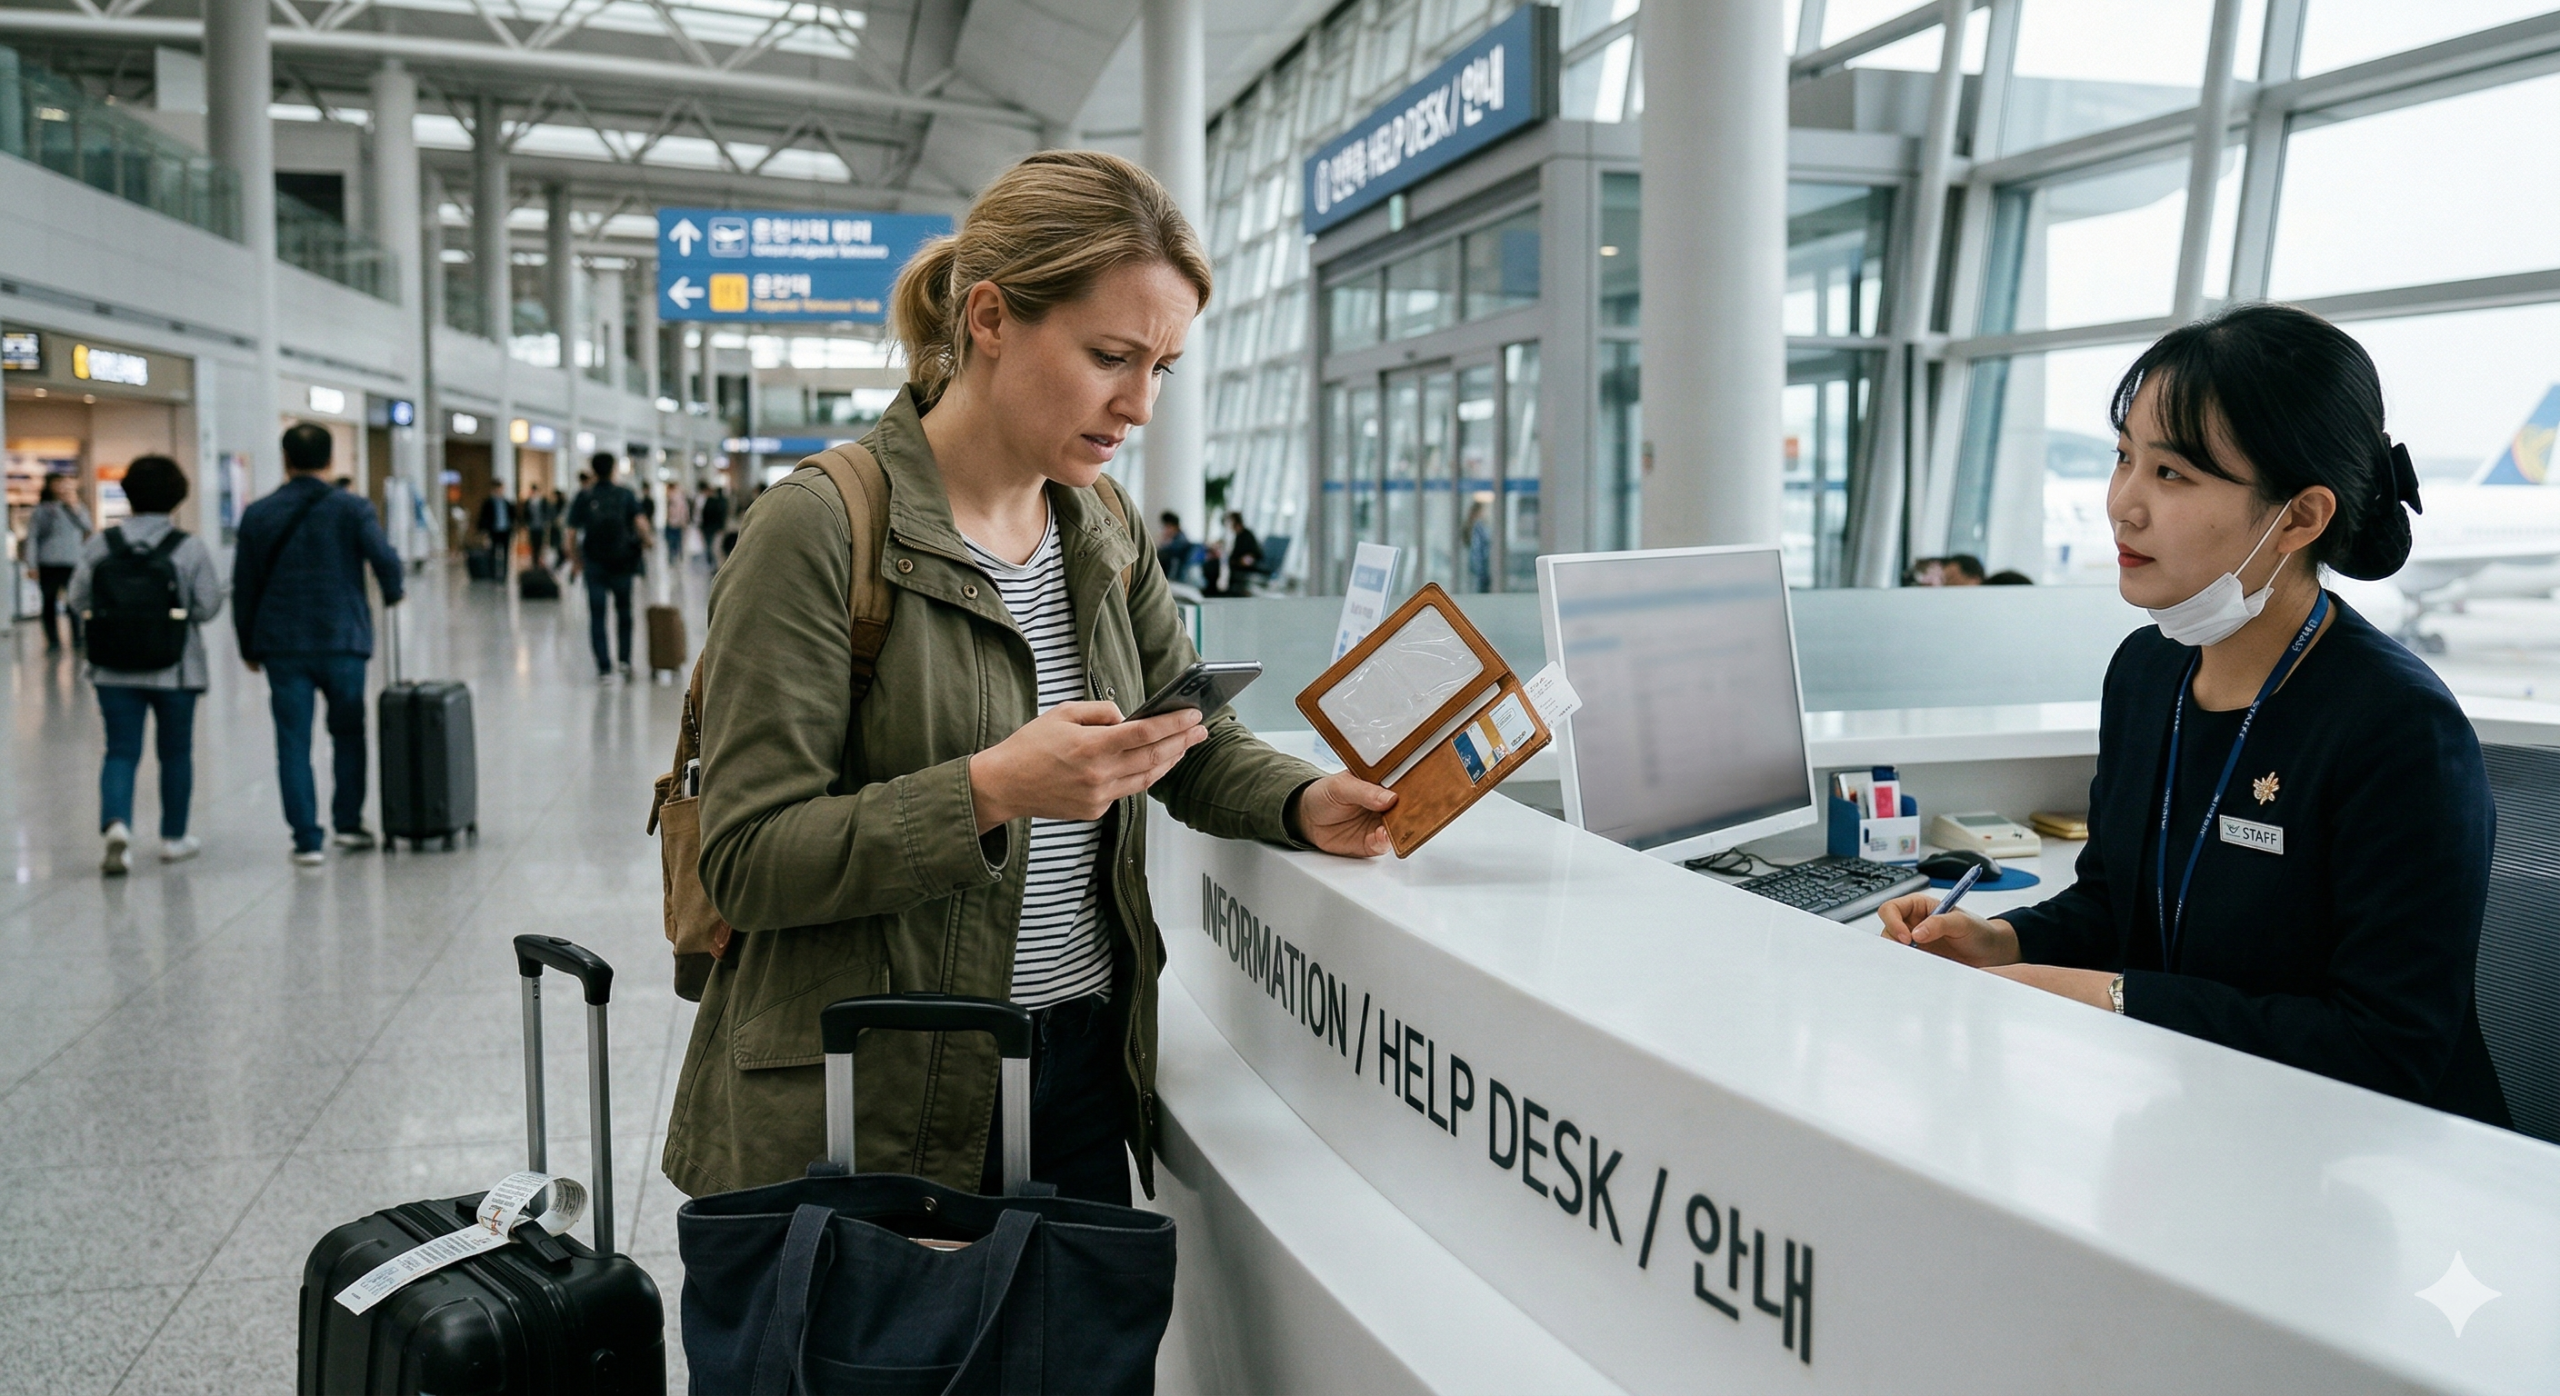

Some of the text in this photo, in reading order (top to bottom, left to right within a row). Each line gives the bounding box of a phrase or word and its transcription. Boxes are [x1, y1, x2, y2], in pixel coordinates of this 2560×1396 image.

[1368, 115, 1405, 178] HELP
[1405, 85, 1450, 157] DESK
[2242, 827, 2277, 845] STAFF
[1202, 872, 1814, 1365] INFORMATION / HELP DESK / 안내
